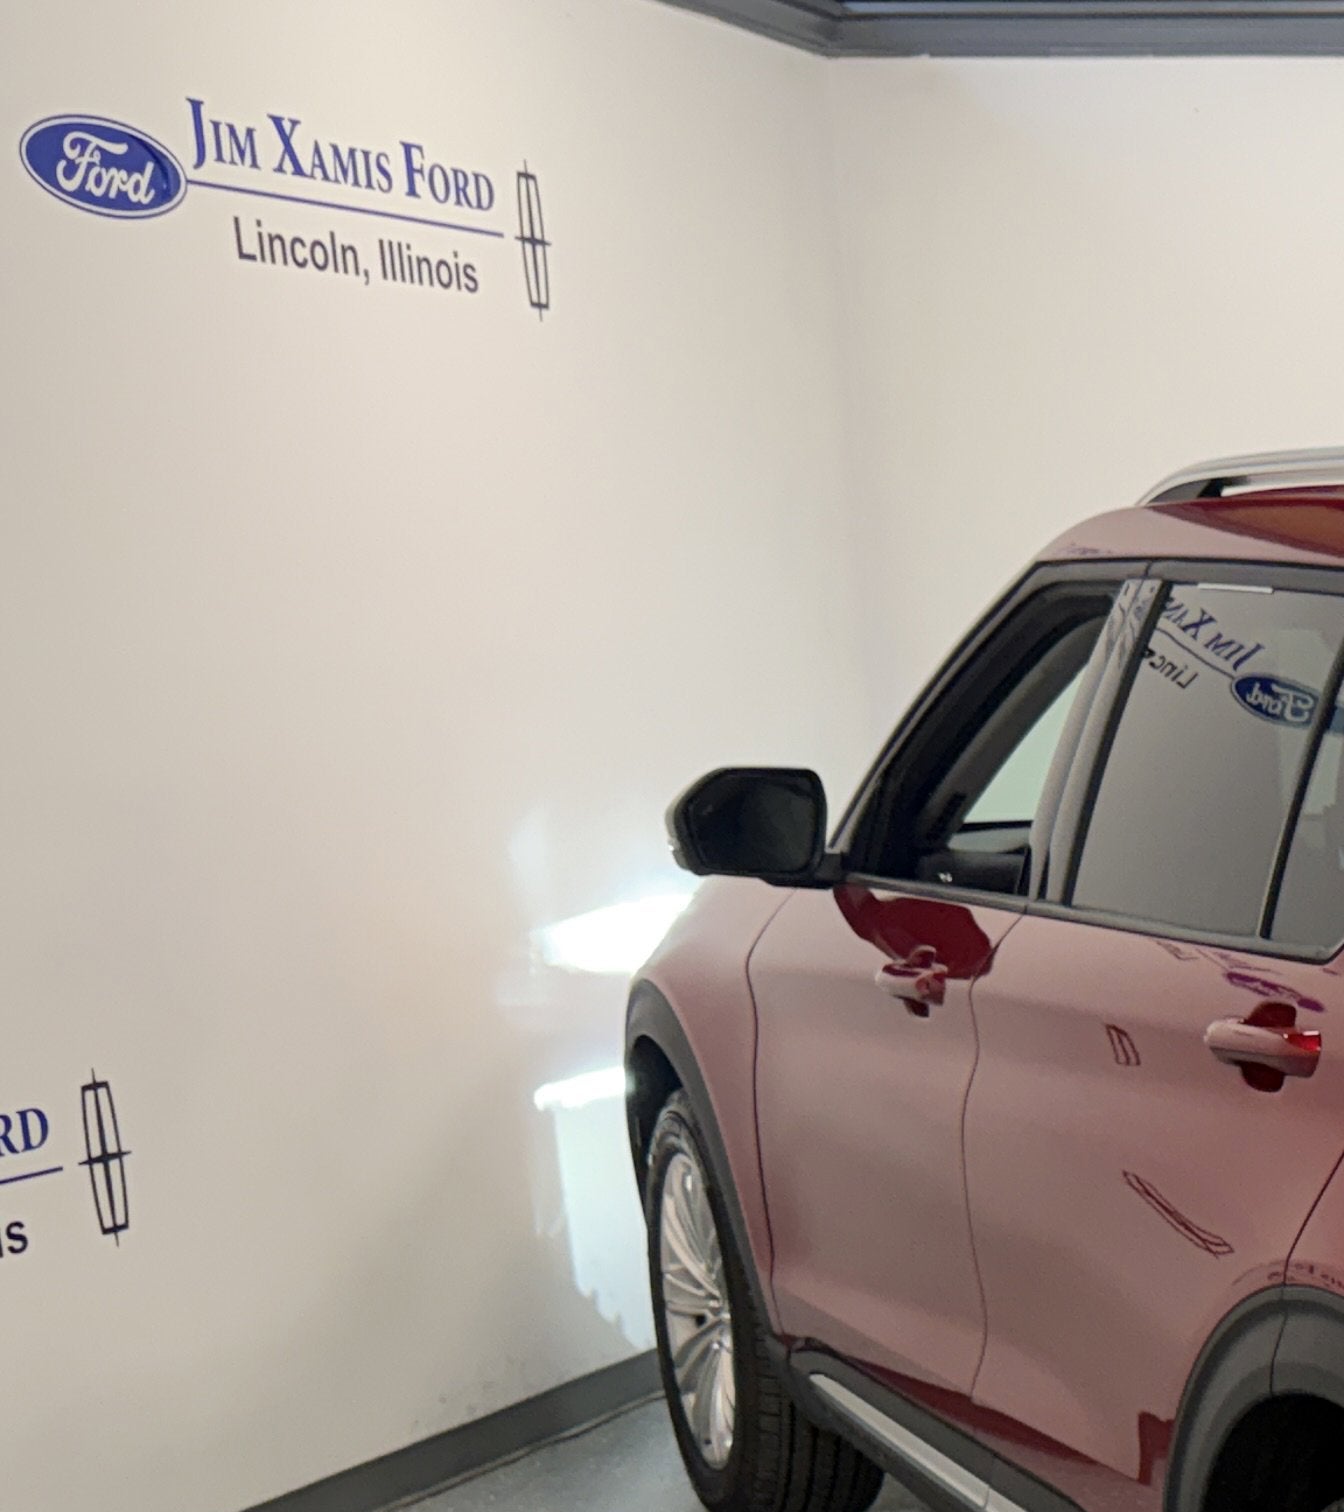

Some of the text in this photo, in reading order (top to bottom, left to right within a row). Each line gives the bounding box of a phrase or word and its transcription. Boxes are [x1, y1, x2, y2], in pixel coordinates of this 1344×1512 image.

[56, 131, 155, 205] Ford
[186, 97, 495, 211] JIM XAMIS FORD
[233, 216, 479, 293] Lincoln, Illinois
